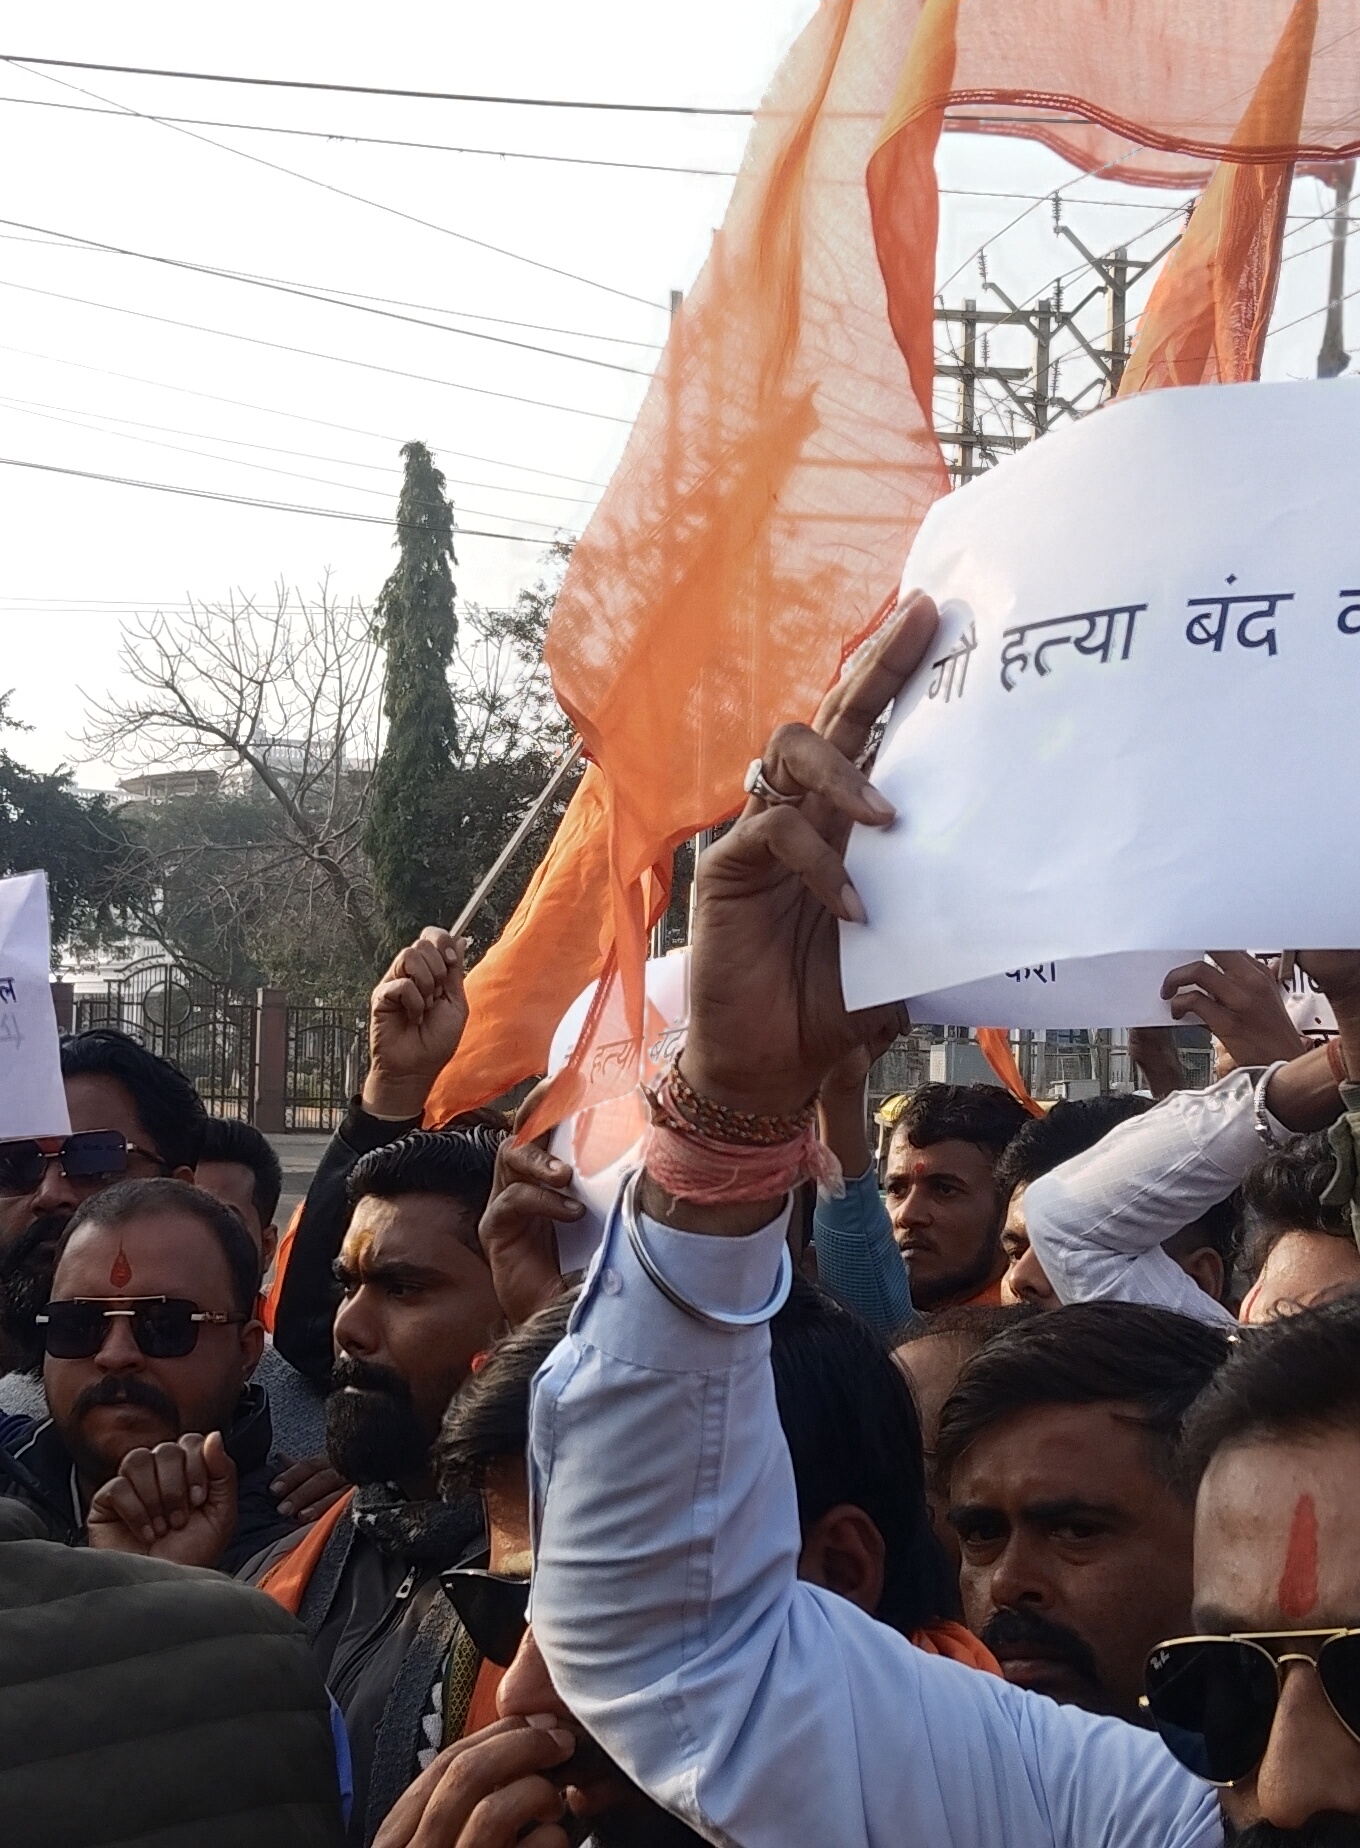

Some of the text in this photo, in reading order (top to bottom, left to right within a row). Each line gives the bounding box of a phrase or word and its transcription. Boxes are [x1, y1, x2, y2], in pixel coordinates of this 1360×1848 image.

[928, 620, 978, 704] गौ
[1000, 603, 1150, 693] हत्या
[1185, 574, 1295, 657] बंद
